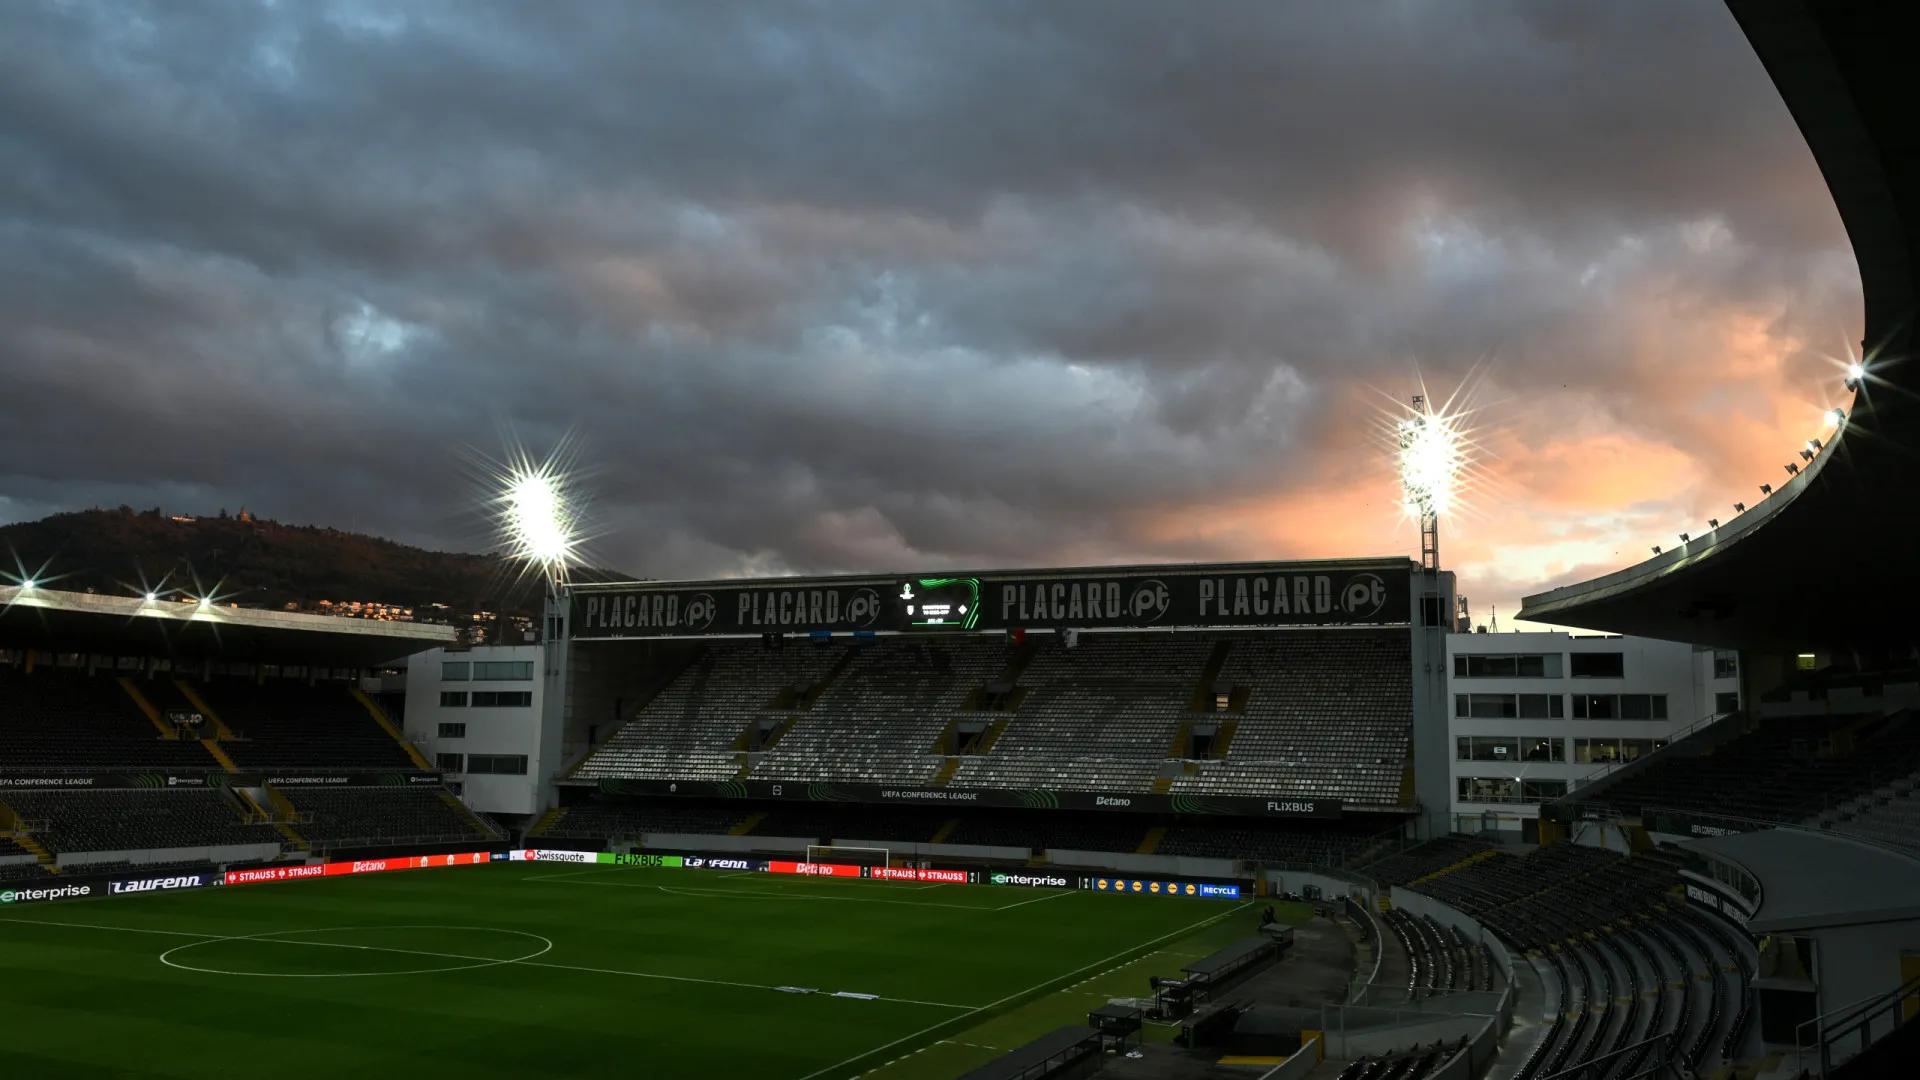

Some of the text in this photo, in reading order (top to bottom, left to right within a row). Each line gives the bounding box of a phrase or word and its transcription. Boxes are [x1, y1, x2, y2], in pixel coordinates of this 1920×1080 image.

[1002, 581, 1169, 620] PLACARD.pt
[1198, 574, 1386, 617] PLACARD.pt
[586, 594, 716, 628] PLACARD.pt
[737, 589, 880, 625] PLACARD.pt
[14, 778, 63, 786] CONFERENCE
[882, 790, 978, 801] UEFA CONFERENCE LEAGUE
[1096, 796, 1131, 807] Betano
[536, 850, 584, 862] Swissquote
[353, 861, 386, 873] Betano
[796, 863, 833, 875] Betano
[239, 866, 322, 882] STRAUSS STRAUSS
[882, 869, 963, 881] STRAUSS STRAUSS
[992, 874, 1067, 888] enterprise
[0, 884, 91, 903] enterprise
[1203, 886, 1237, 895] RECYCLE
